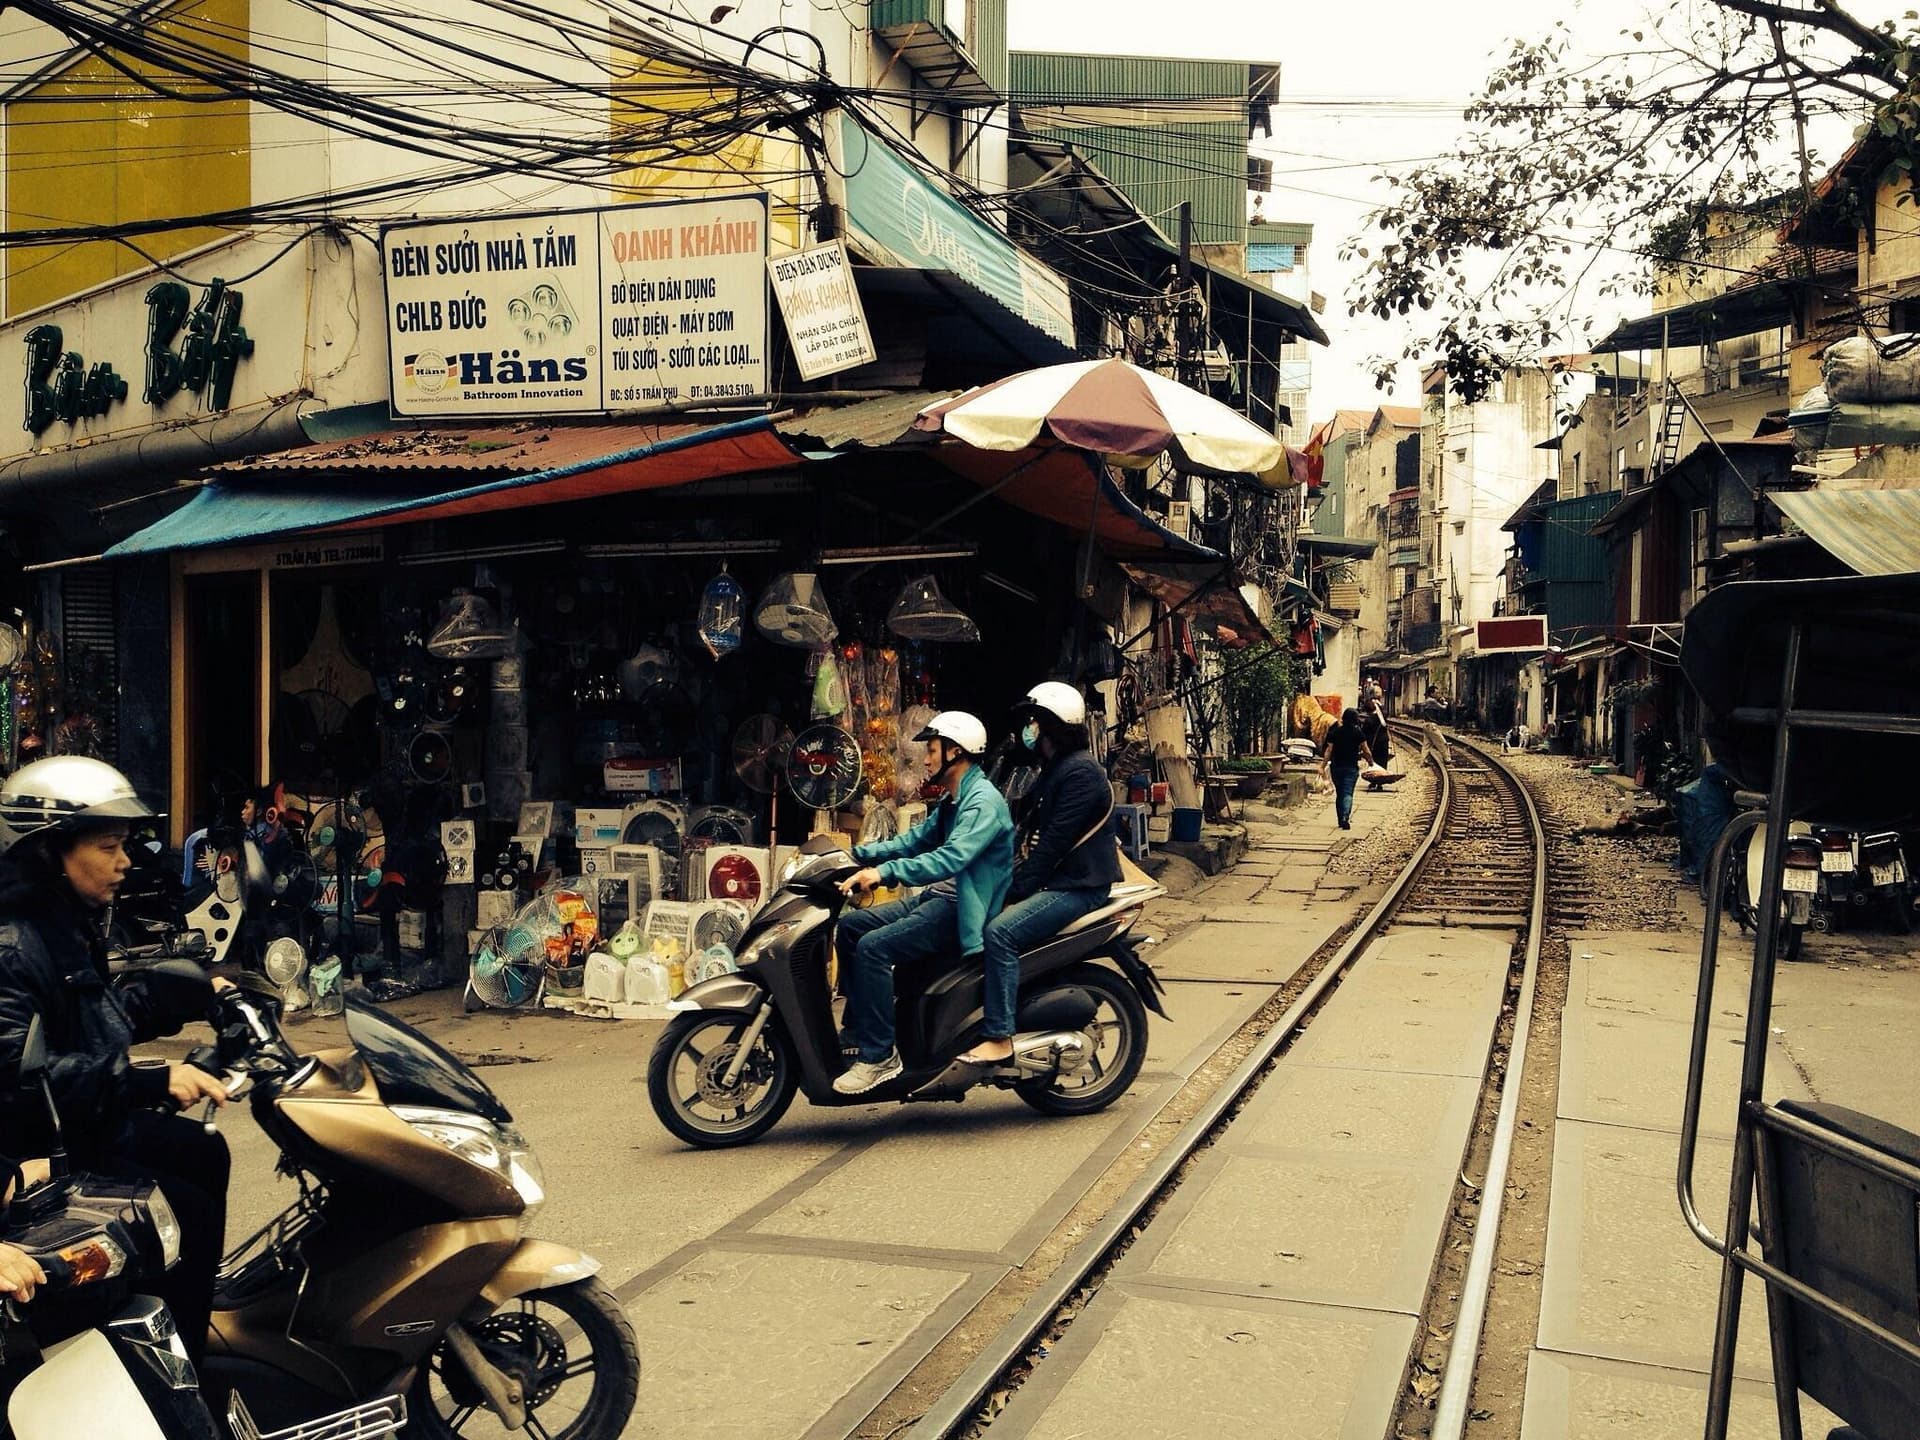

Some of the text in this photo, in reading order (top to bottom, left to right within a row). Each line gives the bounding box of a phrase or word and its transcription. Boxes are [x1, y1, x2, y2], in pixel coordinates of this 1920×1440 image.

[392, 225, 576, 277] ĐÈN SƯỞI NHÀ TẮM
[614, 217, 757, 263] OANH KHÁNH
[629, 278, 655, 307] ĐIỆN
[659, 276, 681, 302] DÂN
[685, 277, 716, 303] DỤNG
[396, 290, 487, 332] CHLB ĐỨC
[612, 317, 640, 341] QUẠT
[643, 311, 669, 340] ĐIỆN
[680, 309, 704, 334] MÁY
[709, 310, 734, 332] BƠM
[459, 350, 588, 385] Häns
[612, 347, 629, 371] TÚI
[632, 341, 658, 370] SƯỞI
[669, 339, 694, 369] SƯỞI
[698, 342, 721, 366] CÁC
[463, 387, 583, 401] Bathroom Innovation
[635, 389, 641, 400] 5
